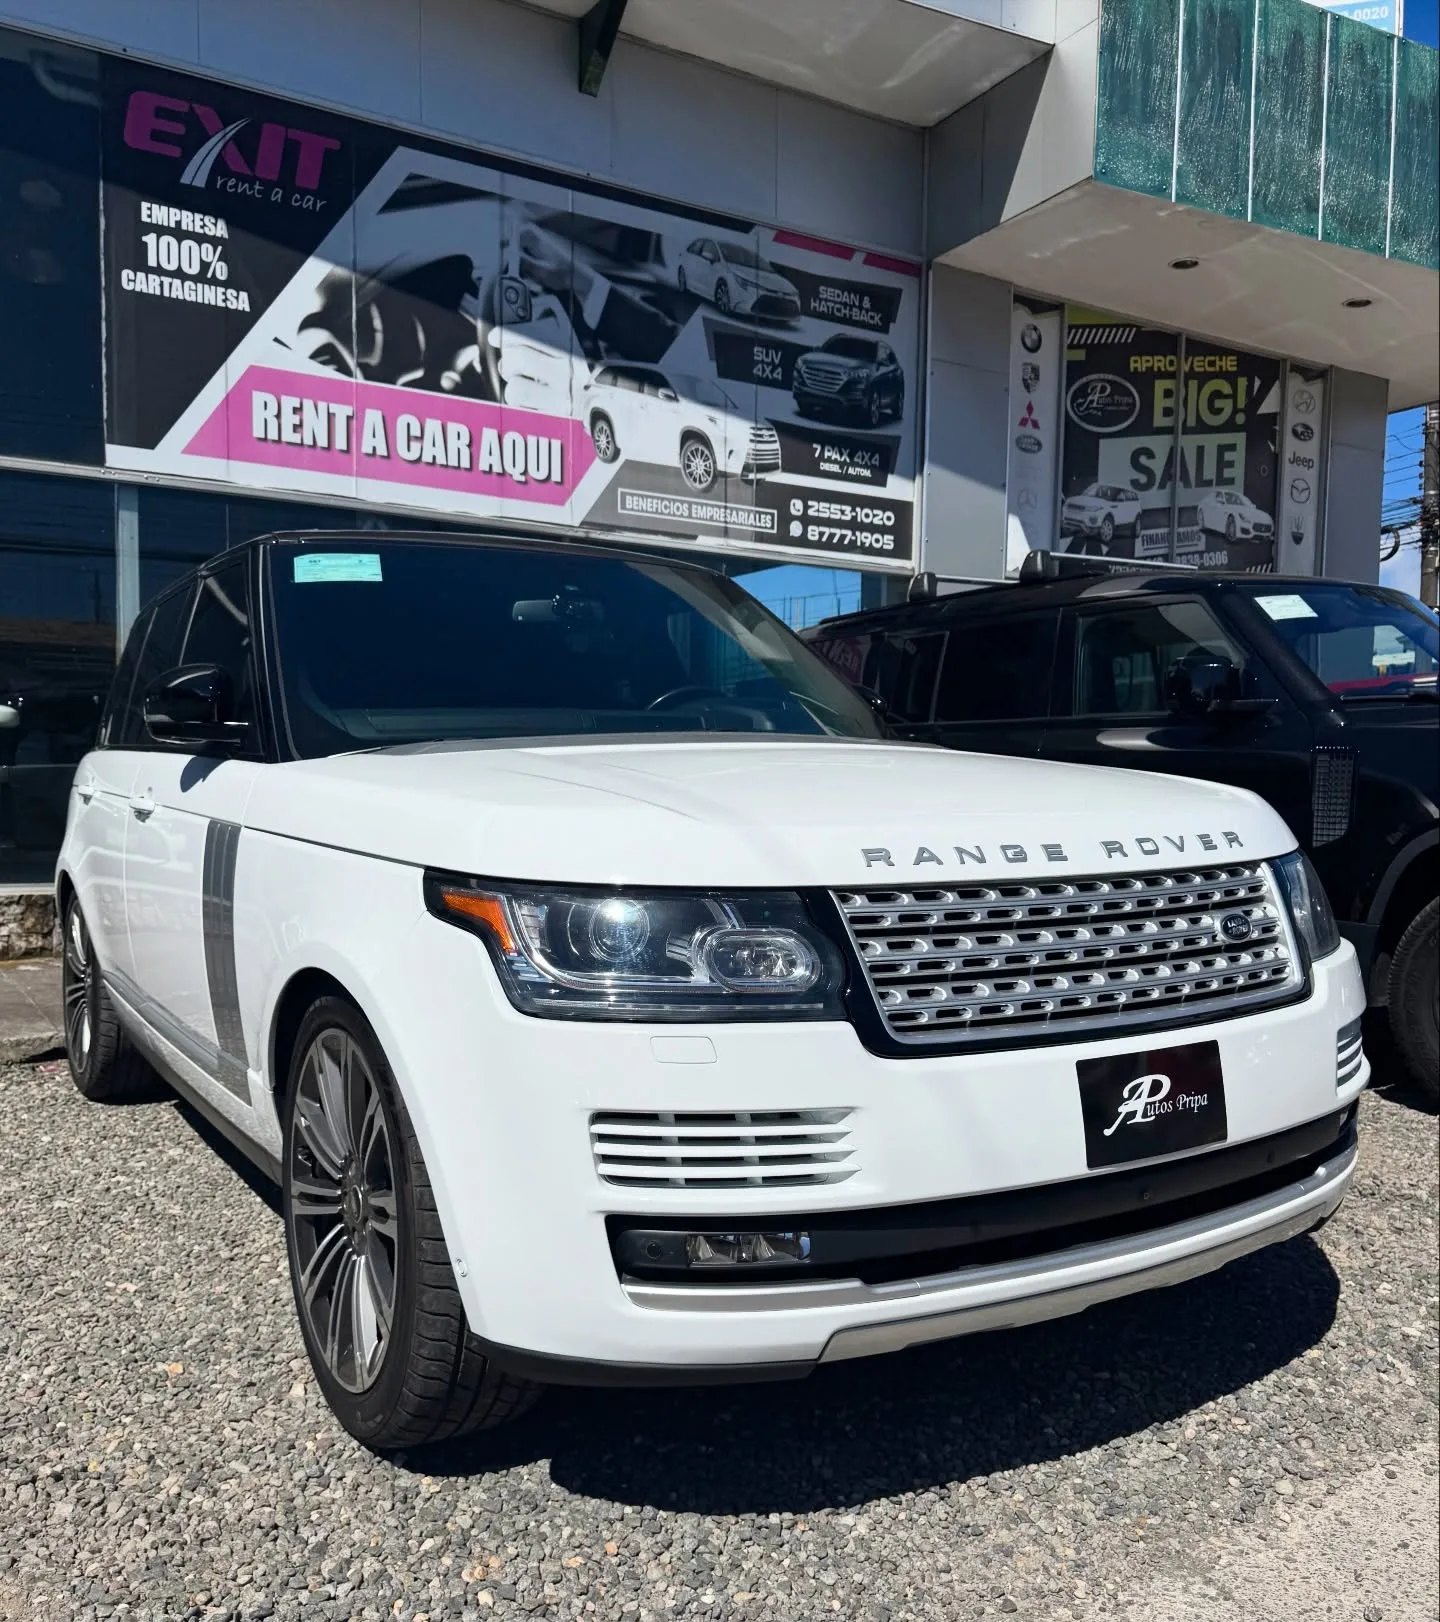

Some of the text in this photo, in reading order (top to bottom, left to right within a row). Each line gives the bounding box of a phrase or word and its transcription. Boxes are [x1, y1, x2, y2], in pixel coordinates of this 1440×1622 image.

[123, 90, 341, 190] EXIT
[216, 175, 327, 213] rent a car
[140, 201, 229, 239] EMPRESA
[141, 232, 229, 280] 100%
[121, 269, 250, 312] CARTAGINESA
[819, 286, 872, 308] SEDAN &
[810, 298, 883, 326] HATCH-BACK
[753, 346, 782, 365] SUV
[1129, 355, 1238, 372] APROVECHE
[1152, 376, 1249, 428] BIG!
[251, 390, 564, 486] RENT A CAR AQUI
[812, 443, 822, 458] 7
[824, 445, 851, 463] PAX
[819, 462, 842, 473] DIESEL
[1129, 443, 1238, 492] SALE
[1288, 451, 1315, 471] Jeep
[625, 494, 772, 529] BENEFICIOS EMPRESARIALES
[807, 500, 895, 527] 2553-1020
[807, 525, 895, 550] 8777-1905
[860, 831, 1244, 868] RANGE ROVER
[1175, 1091, 1209, 1113] Pripa
